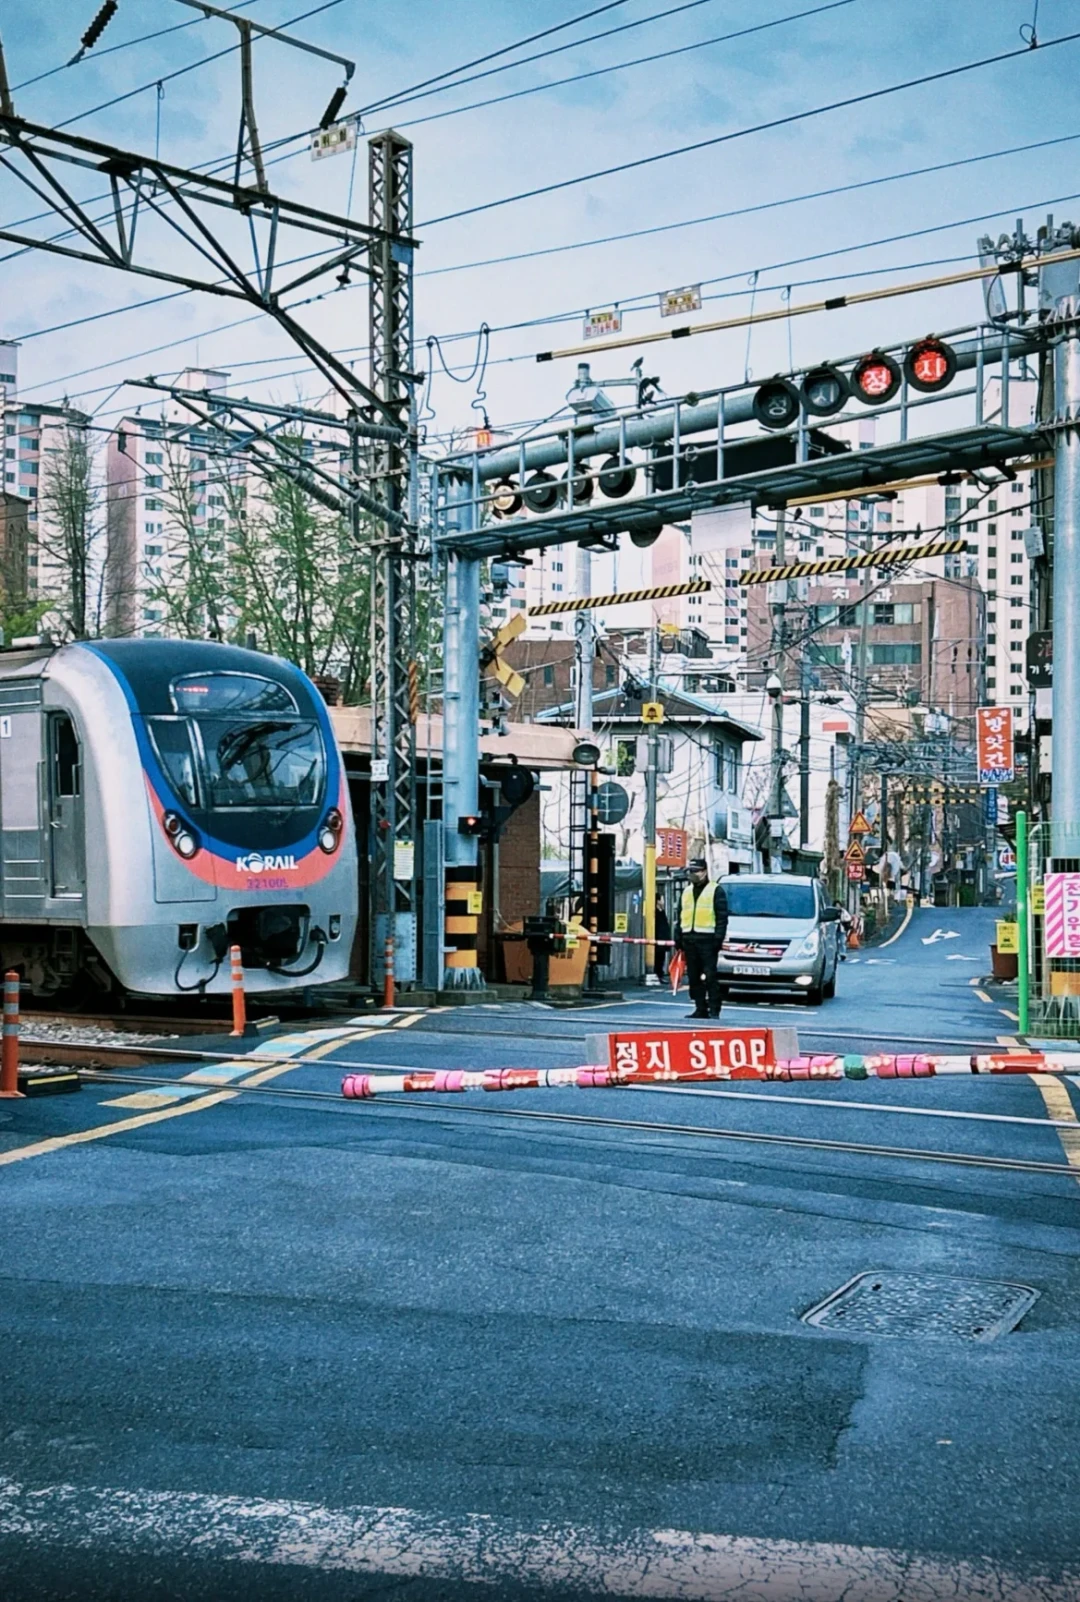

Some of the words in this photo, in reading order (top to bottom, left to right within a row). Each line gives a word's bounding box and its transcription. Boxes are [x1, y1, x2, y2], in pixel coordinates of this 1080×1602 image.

[832, 587, 893, 603] 치과
[3, 719, 8, 735] 1
[984, 716, 1008, 768] 방앗간
[235, 852, 299, 874] KORAIL
[615, 1040, 671, 1075] 정지
[688, 1038, 766, 1073] STOP
